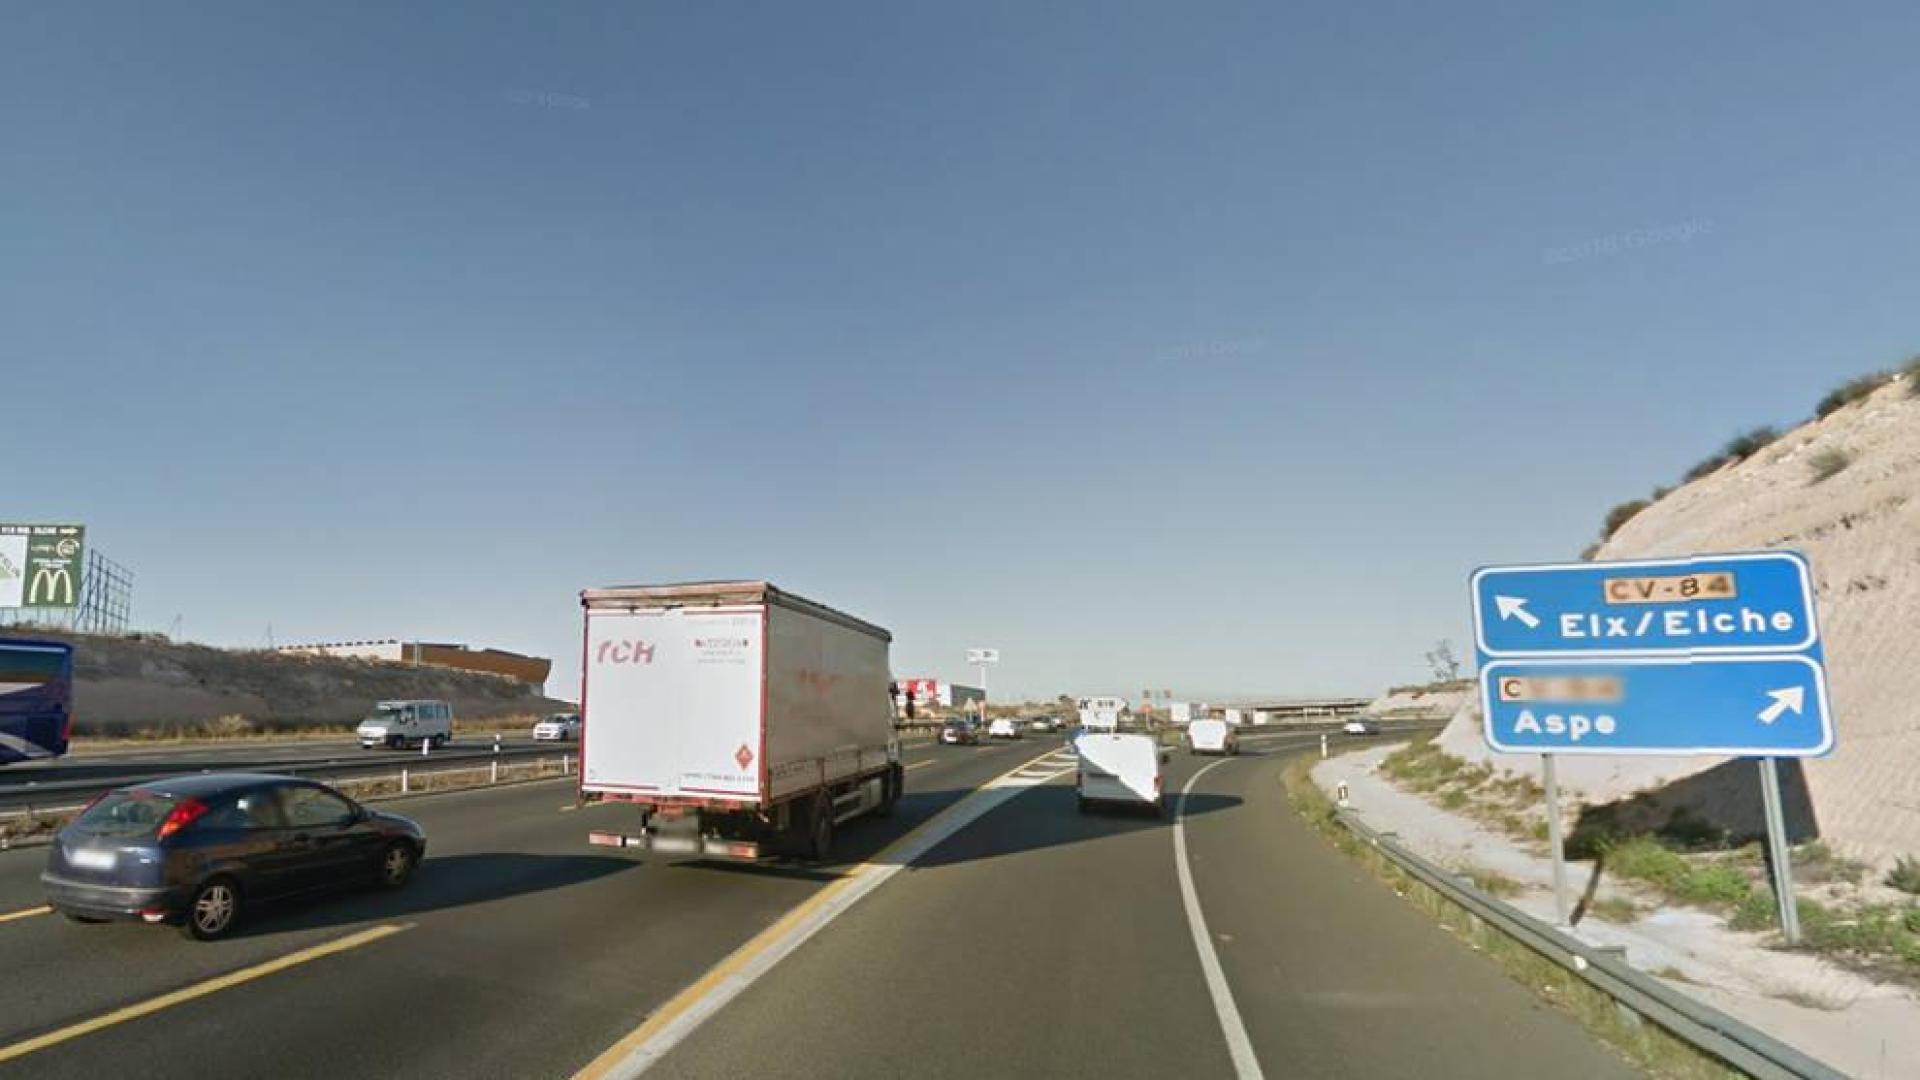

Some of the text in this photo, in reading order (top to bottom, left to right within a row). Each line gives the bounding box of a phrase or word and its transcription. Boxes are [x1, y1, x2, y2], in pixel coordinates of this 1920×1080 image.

[1609, 575, 1731, 600] CV-84
[1559, 608, 1794, 638] Elx/Elche
[1514, 709, 1616, 741] Aspe
